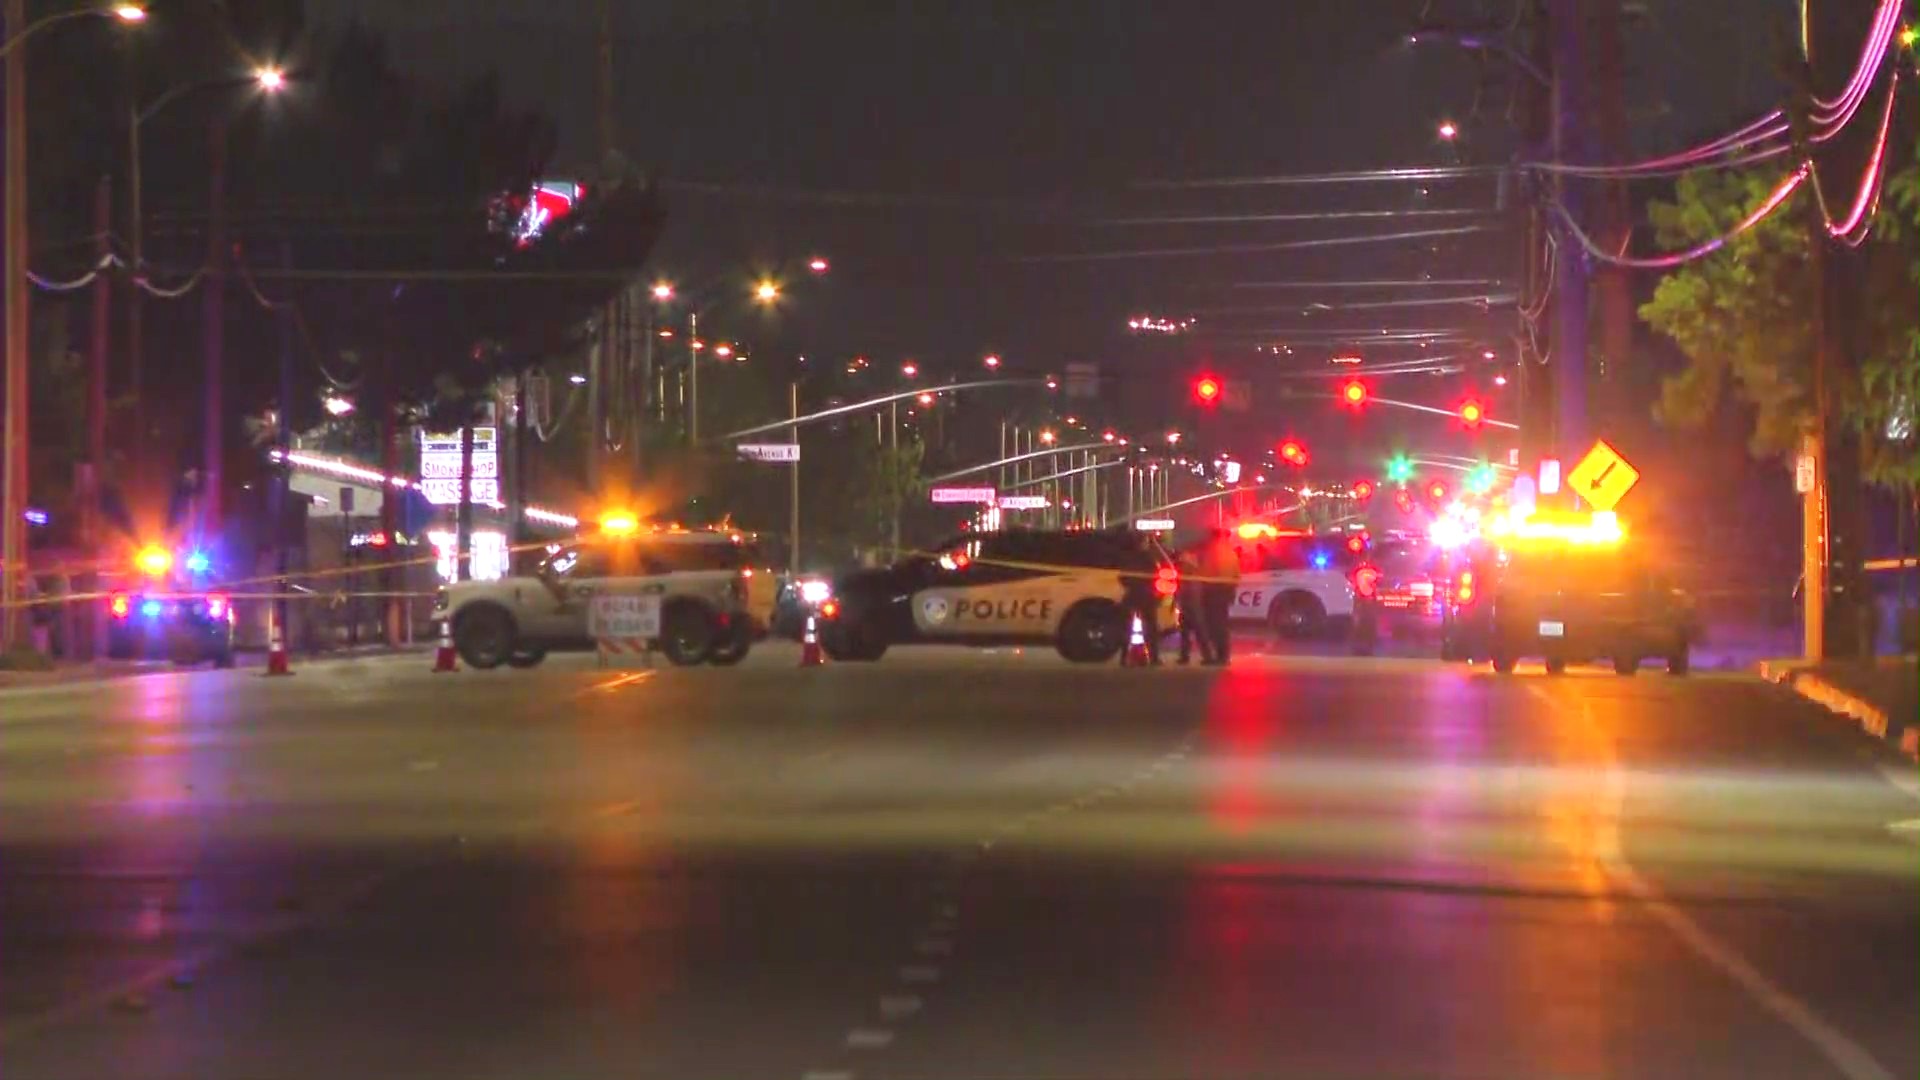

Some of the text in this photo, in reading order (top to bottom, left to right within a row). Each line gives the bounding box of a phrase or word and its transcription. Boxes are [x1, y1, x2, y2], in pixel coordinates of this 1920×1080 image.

[425, 462, 463, 476] SMOKE
[425, 481, 494, 500] MASSGE
[955, 599, 1053, 619] POLICE
